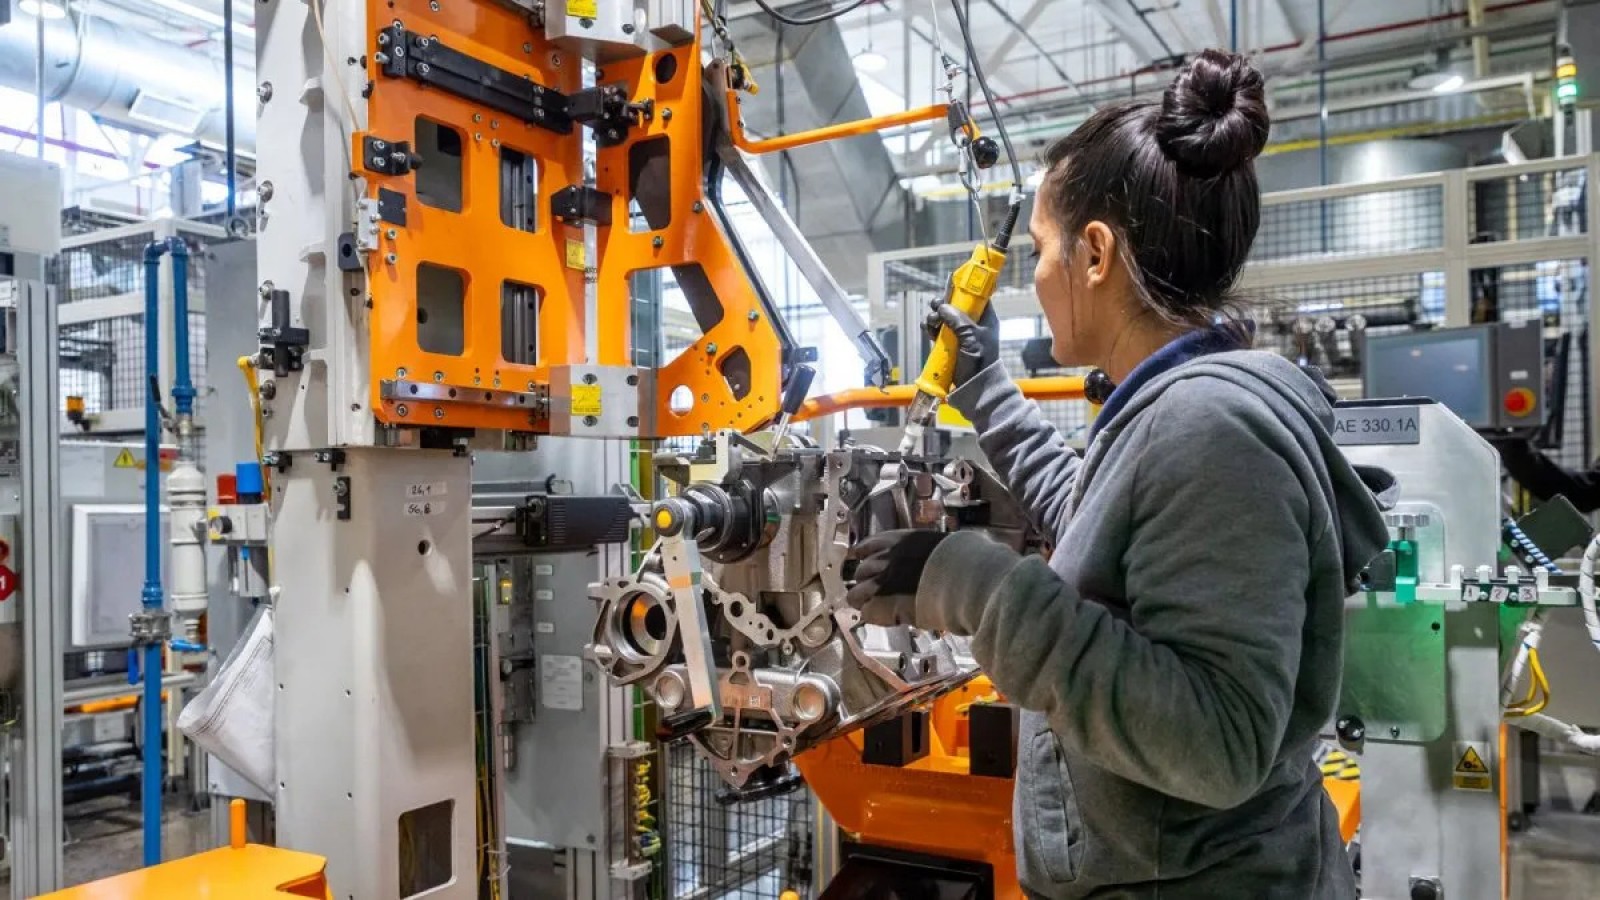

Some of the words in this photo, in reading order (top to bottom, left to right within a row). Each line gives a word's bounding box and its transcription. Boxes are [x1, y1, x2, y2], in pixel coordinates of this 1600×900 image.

[1335, 419, 1356, 433] AE
[1361, 417, 1417, 433] 330.1A
[1522, 588, 1533, 601] 3
